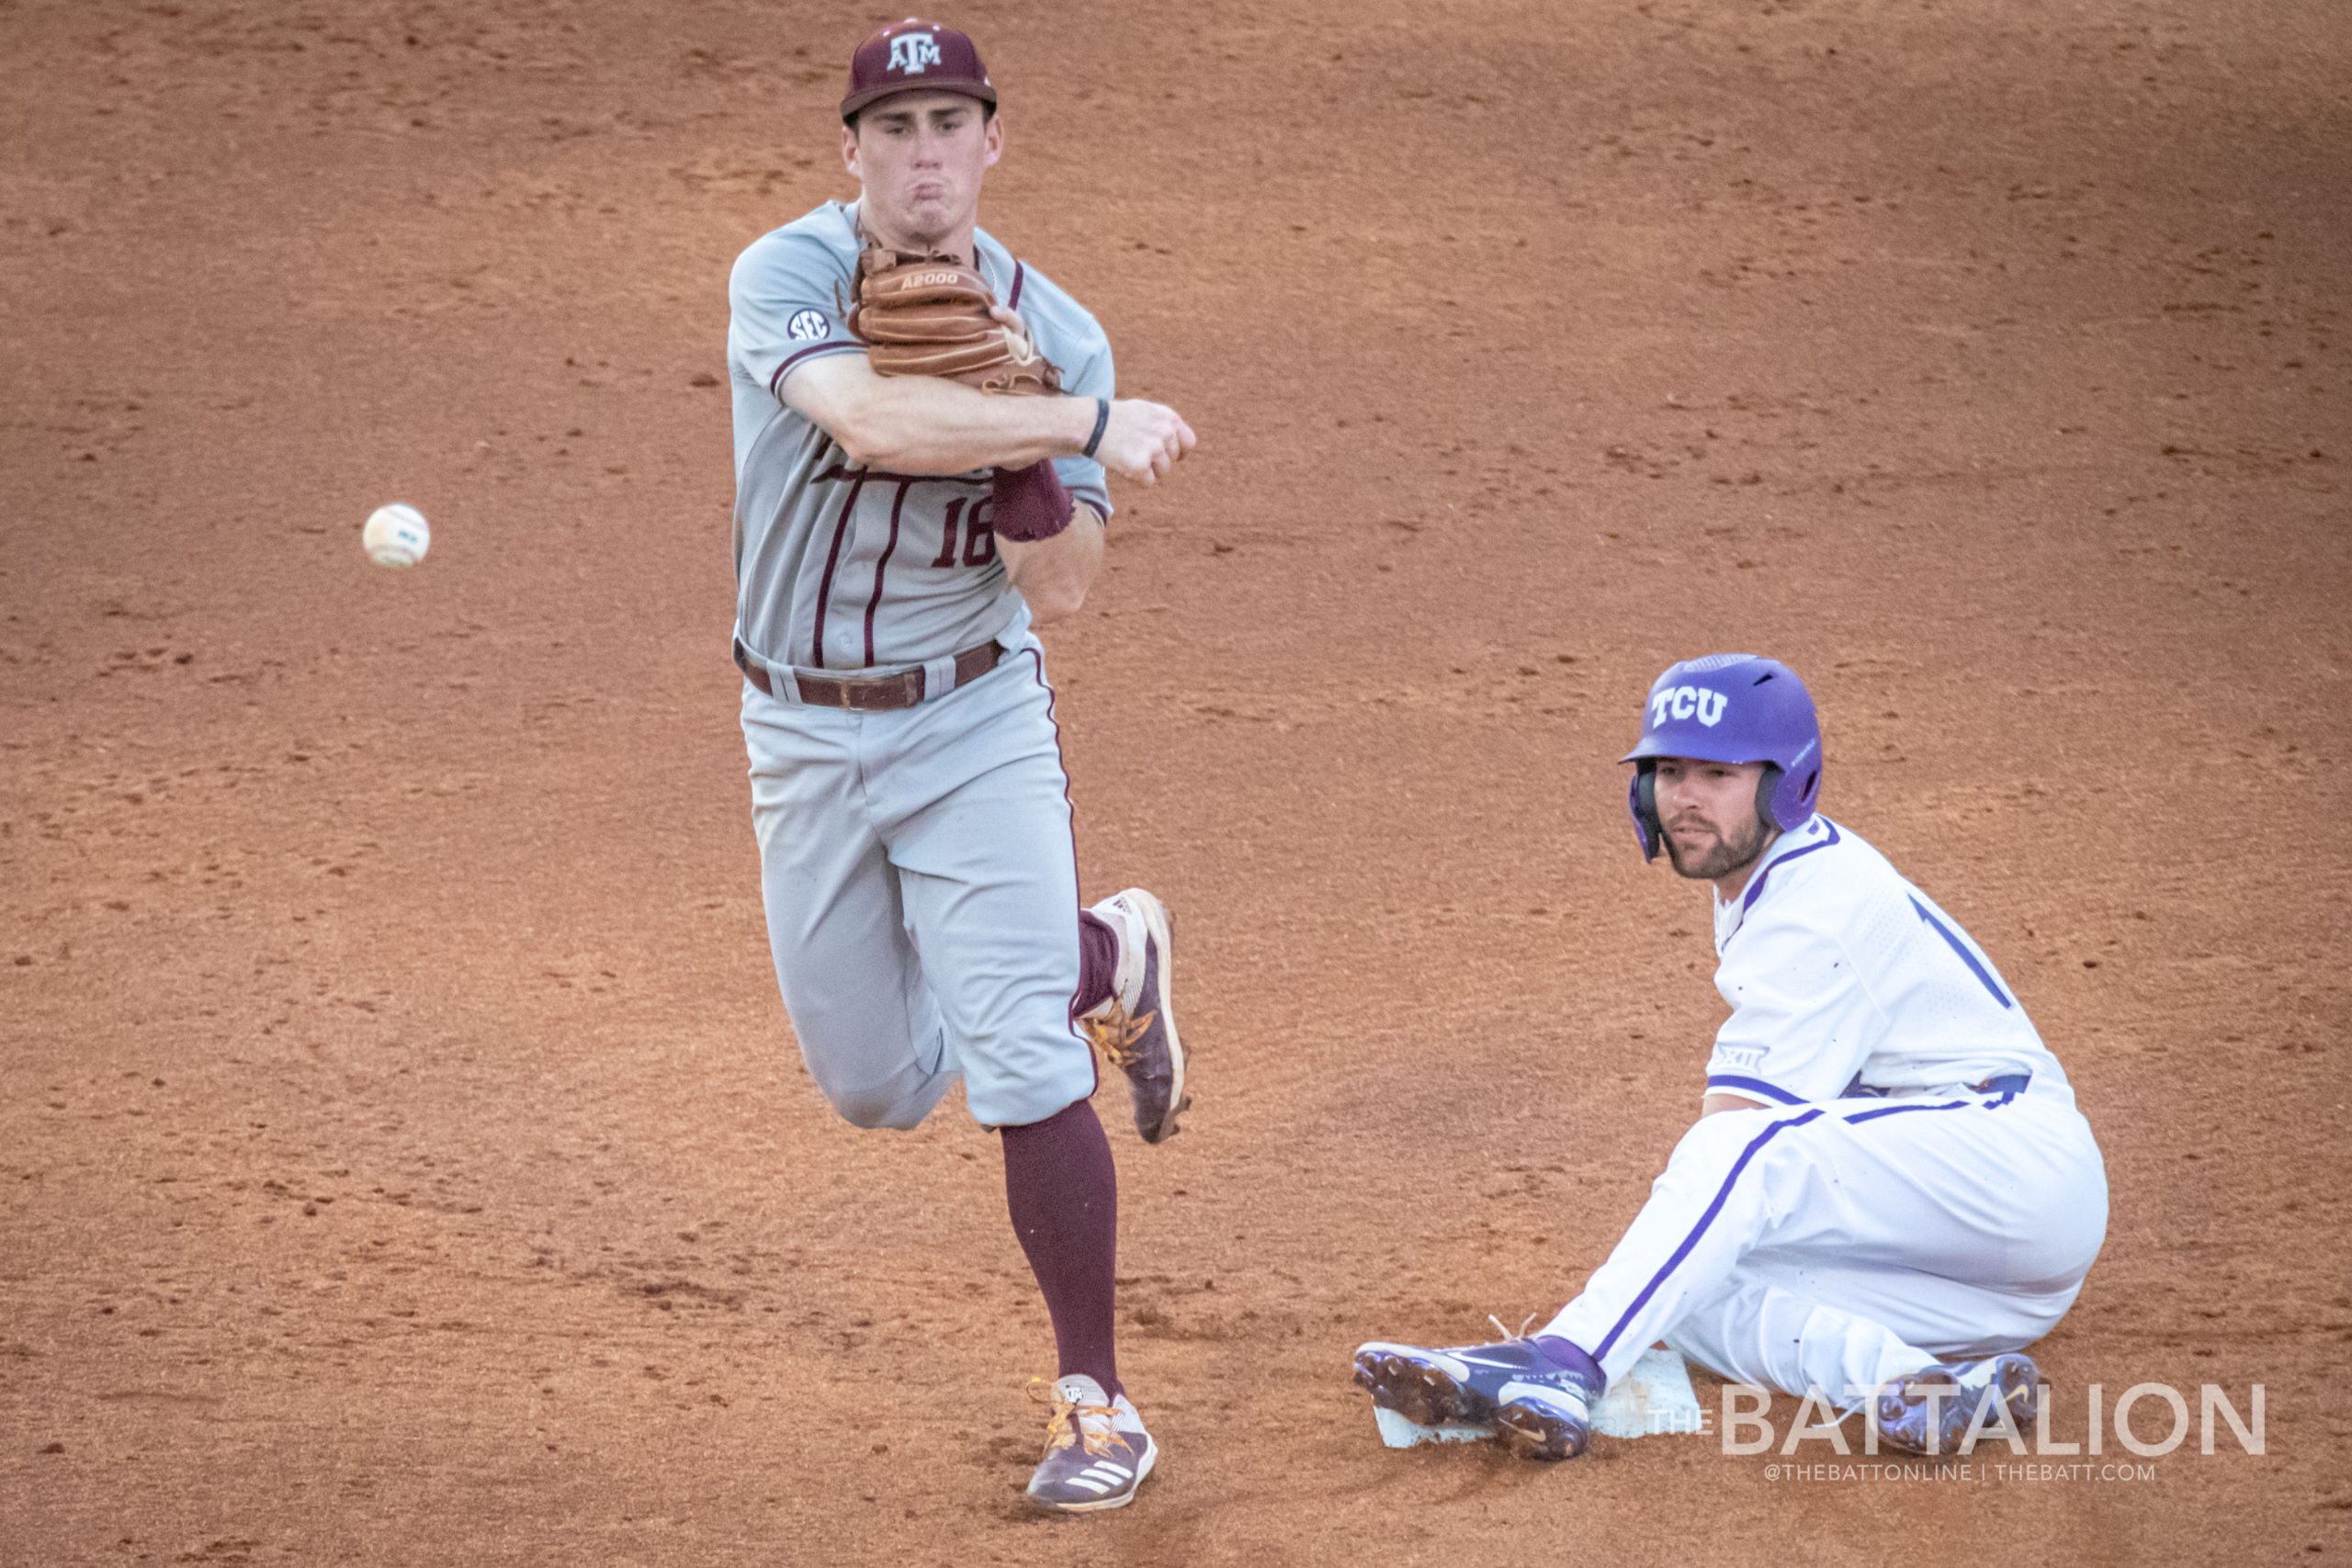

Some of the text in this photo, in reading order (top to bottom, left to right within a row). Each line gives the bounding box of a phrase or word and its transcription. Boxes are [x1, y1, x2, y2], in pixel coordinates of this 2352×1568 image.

[901, 273, 958, 290] A2000
[791, 310, 828, 340] SEC
[931, 497, 996, 568] 16
[1652, 686, 1728, 728] TCU
